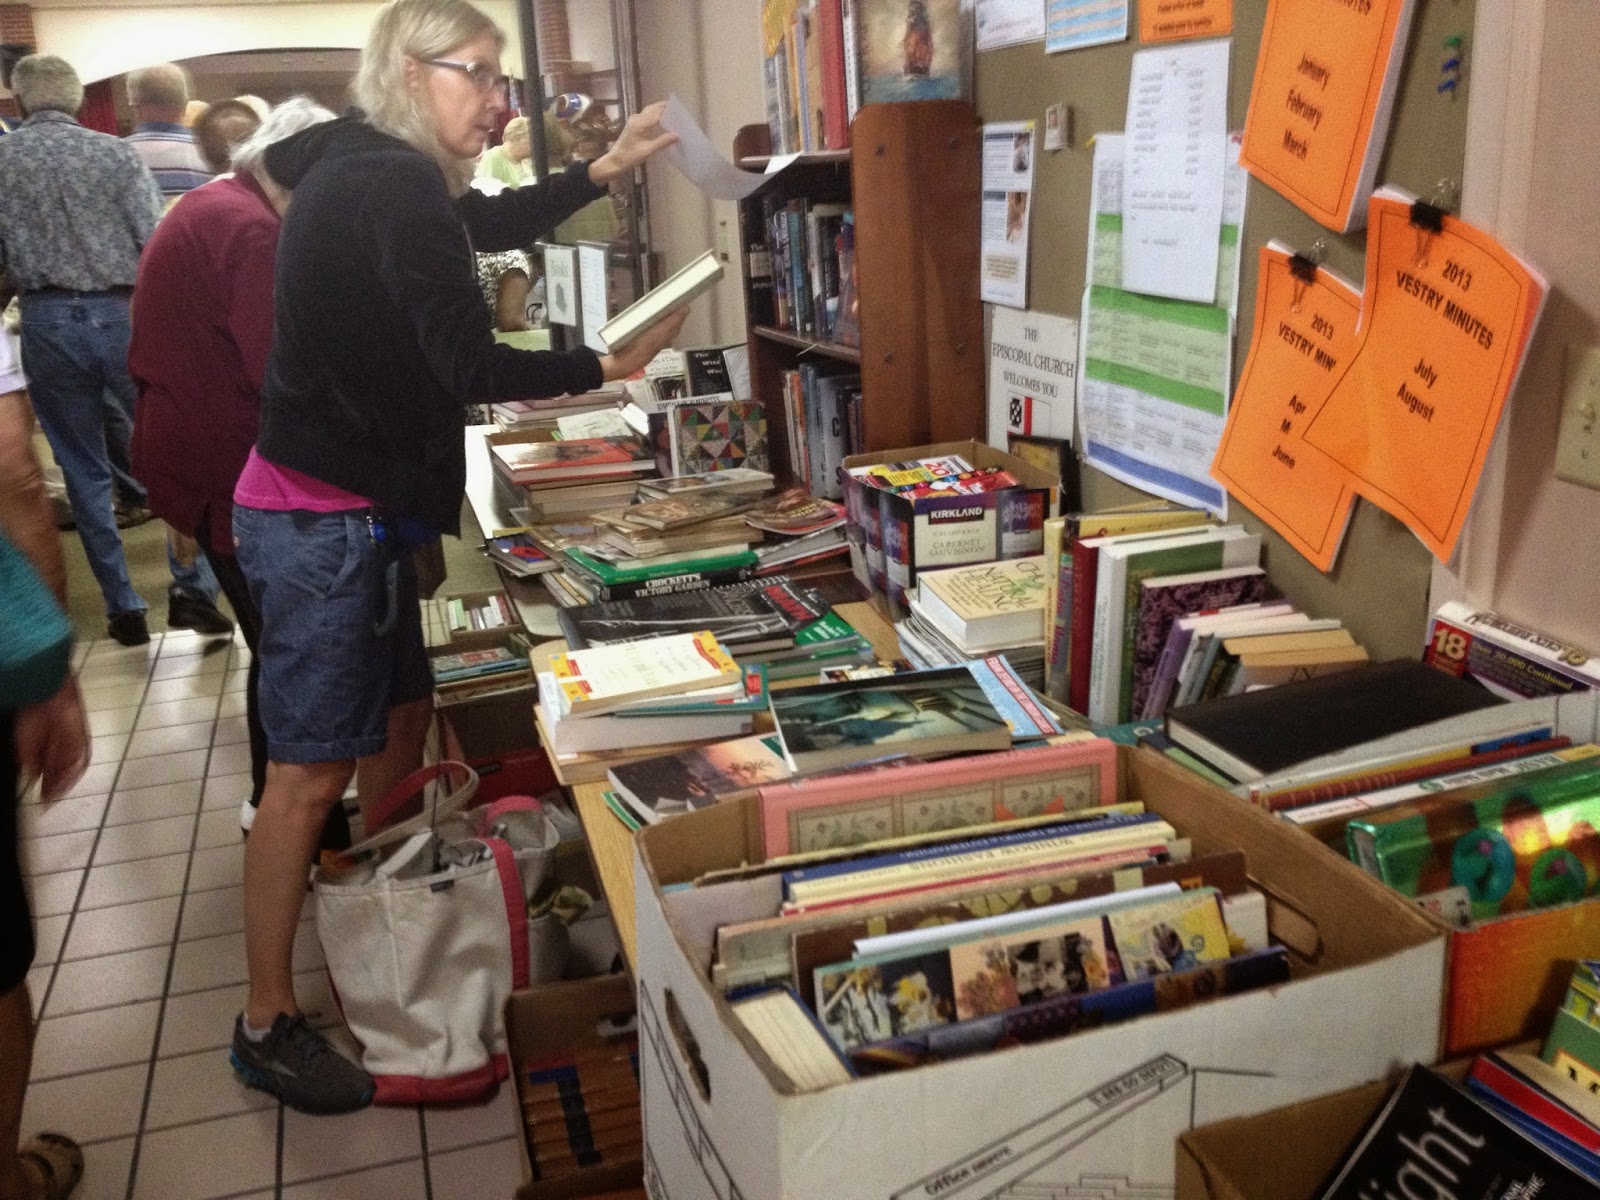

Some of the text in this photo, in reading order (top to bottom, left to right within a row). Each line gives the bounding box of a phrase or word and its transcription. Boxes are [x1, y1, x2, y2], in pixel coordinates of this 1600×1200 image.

[1297, 52, 1330, 91] January
[1286, 89, 1322, 131] February
[1282, 129, 1308, 160] March
[1442, 260, 1472, 292] 2013
[1396, 270, 1494, 350] VESTRY MINUTES
[1024, 327, 1039, 342] THE
[1311, 314, 1335, 340] 2013
[992, 343, 1074, 378] EPISCOPAL CHURCH
[1278, 321, 1337, 372] VESTRY MIN
[1003, 371, 1059, 398] WELCOMES YOU
[1414, 358, 1437, 389] July
[1397, 383, 1434, 423] August
[1272, 444, 1296, 470] June
[931, 507, 983, 520] KIRKLAND
[933, 528, 980, 537] CALIFORNIA
[933, 539, 981, 549] CABERNET
[928, 546, 986, 557] SAUVIGNON
[635, 580, 711, 598] VICTORY GARDEN
[645, 573, 701, 588] CROCKETT'S
[1434, 628, 1467, 661] 18
[909, 836, 1074, 873] WINDOW FASHIONS
